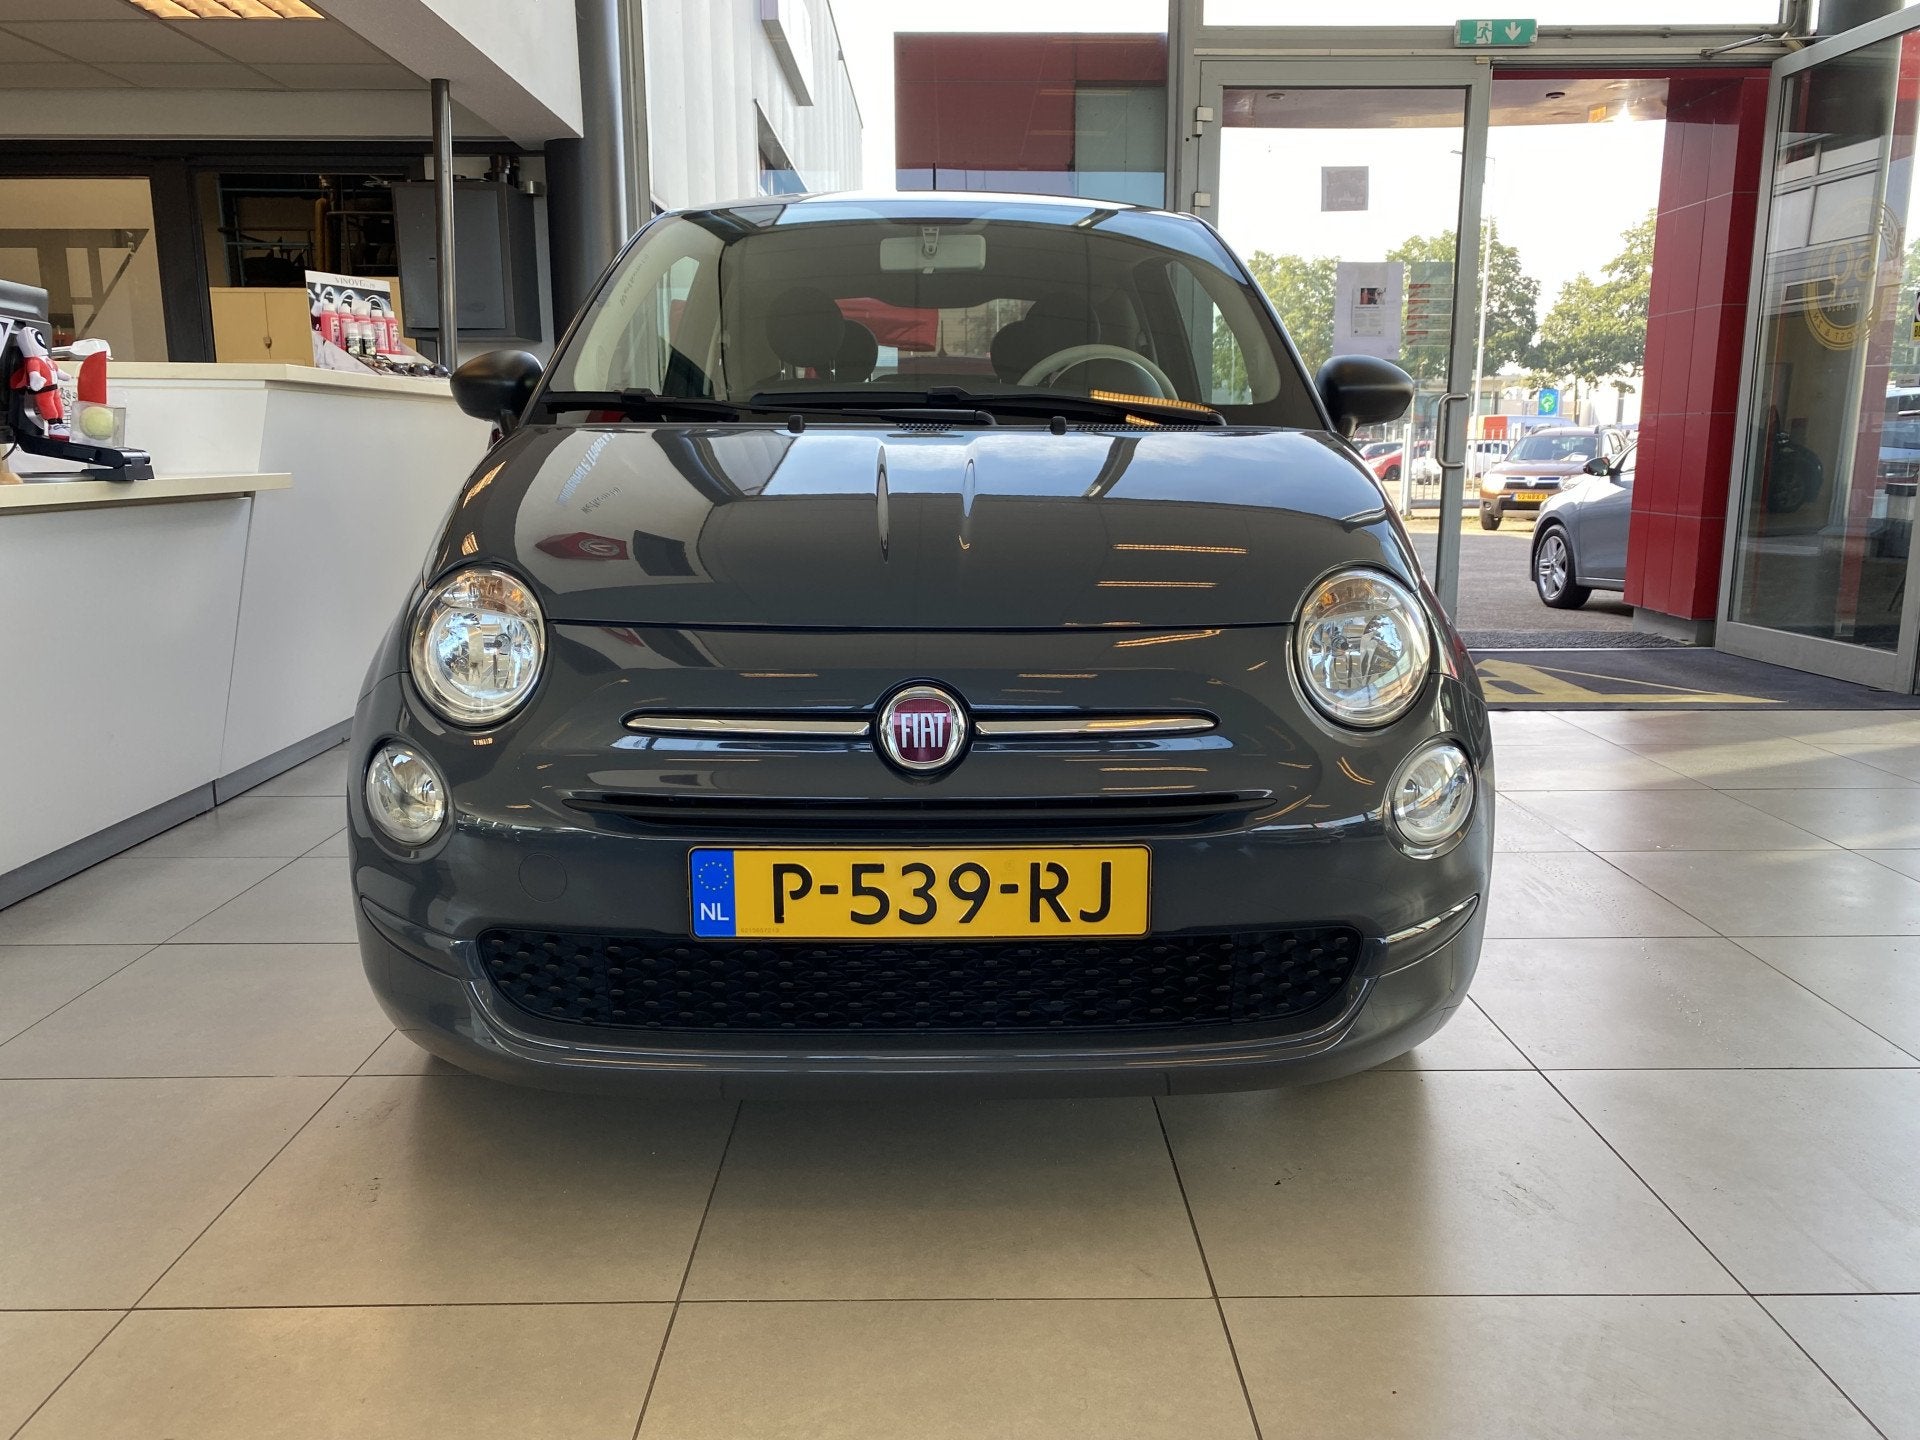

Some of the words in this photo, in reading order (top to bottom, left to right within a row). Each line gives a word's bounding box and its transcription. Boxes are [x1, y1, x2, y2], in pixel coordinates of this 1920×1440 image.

[901, 712, 947, 748] FIAT
[700, 902, 729, 921] NL
[773, 861, 1112, 925] P-539-RJ
